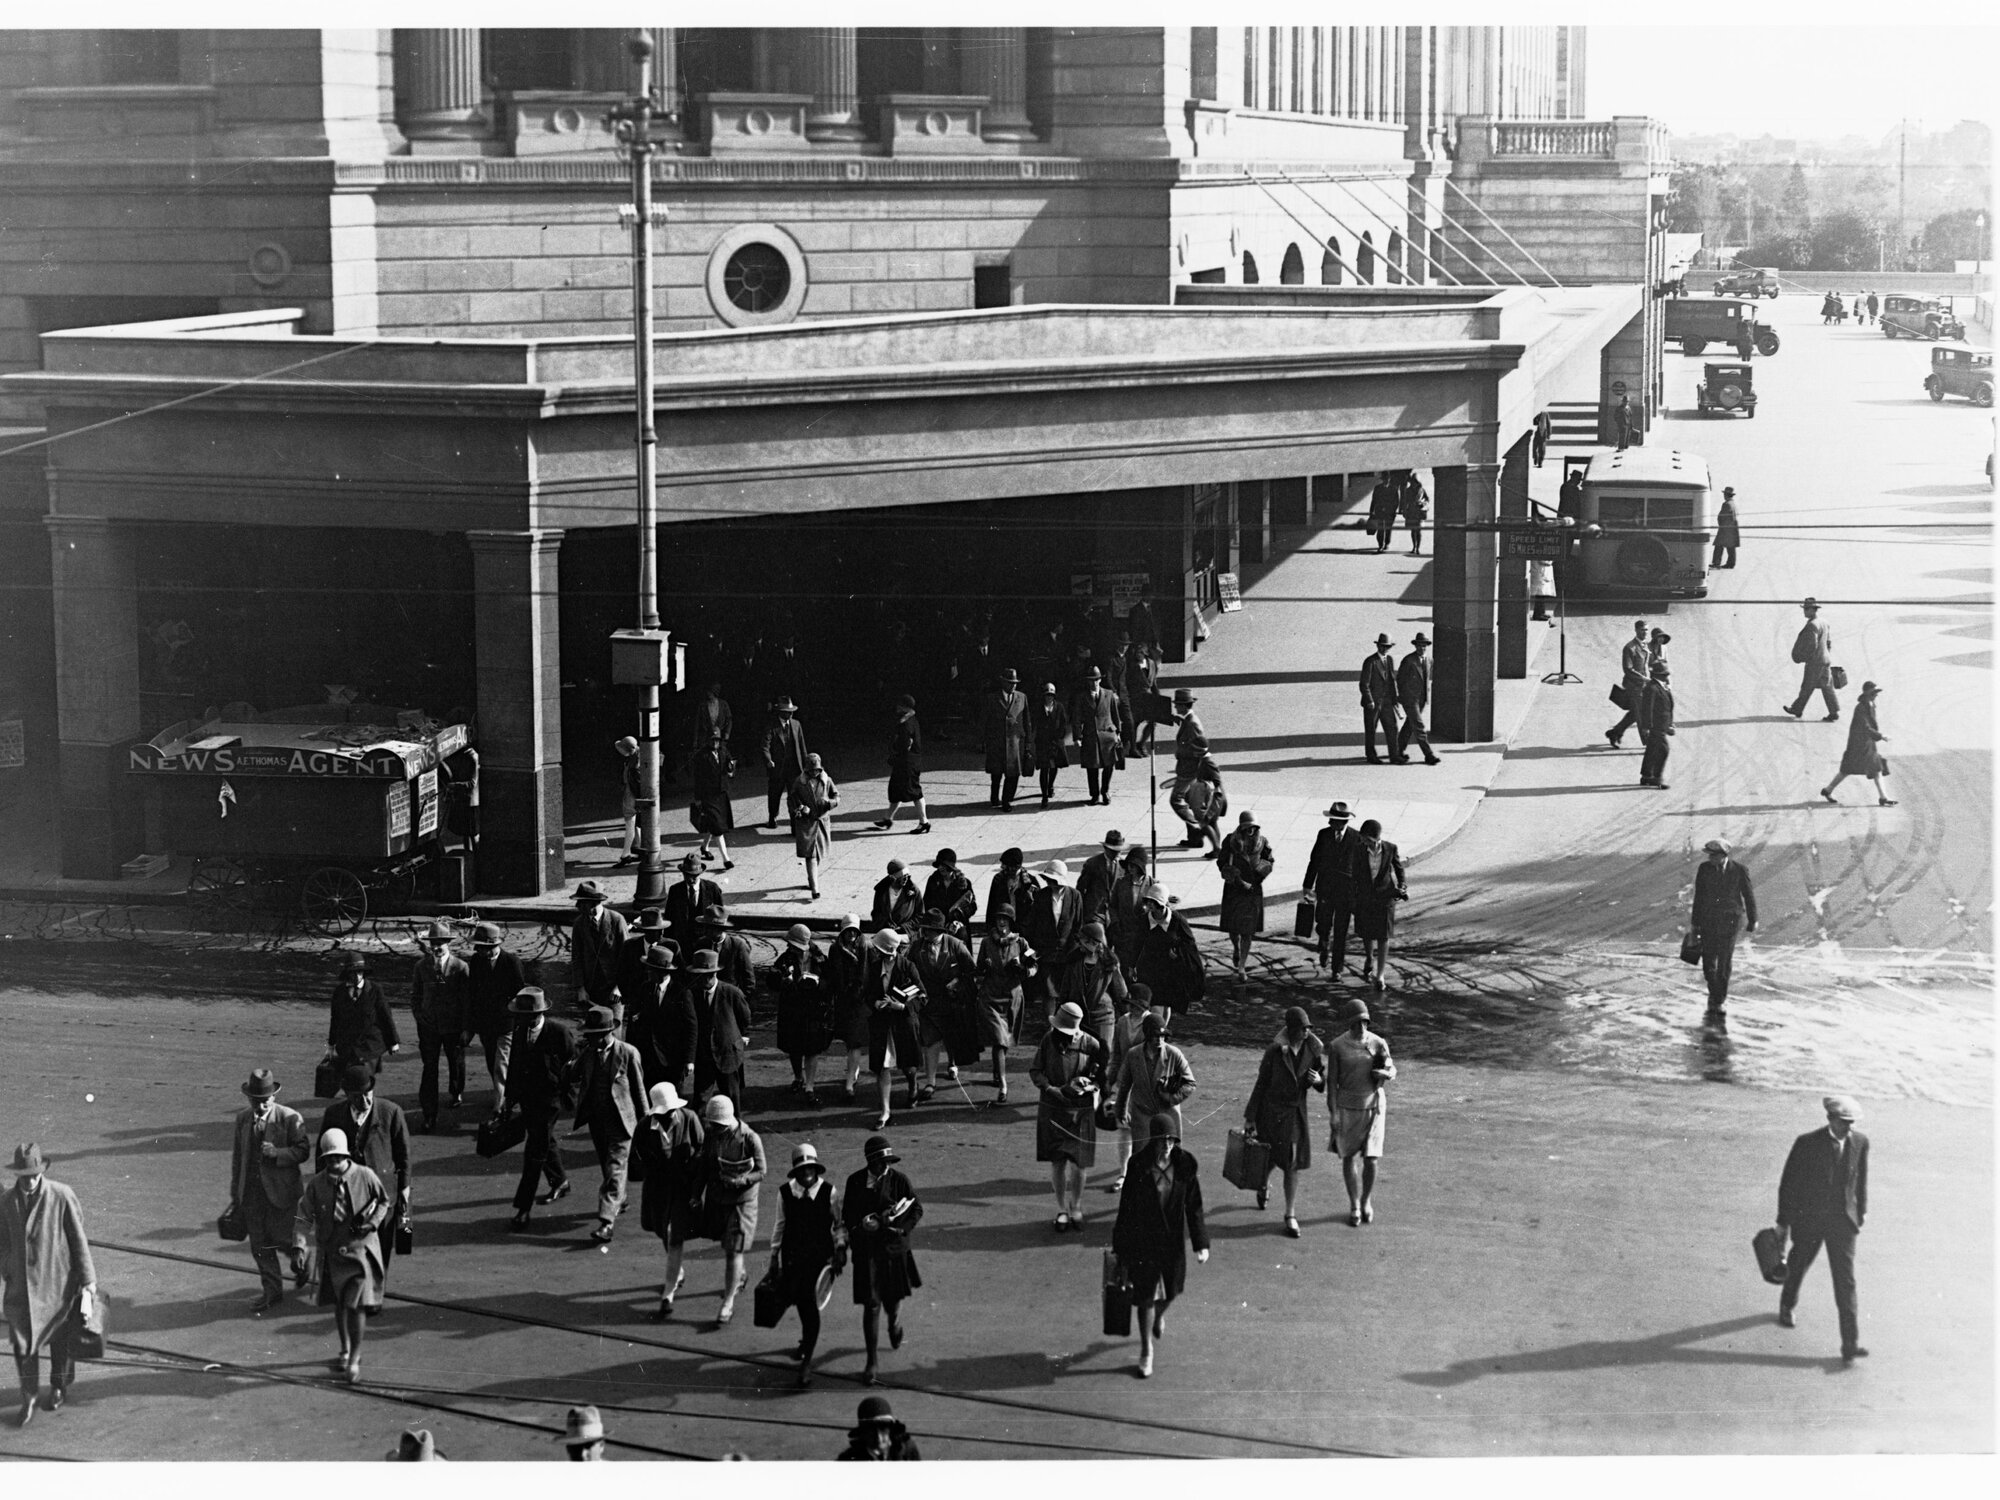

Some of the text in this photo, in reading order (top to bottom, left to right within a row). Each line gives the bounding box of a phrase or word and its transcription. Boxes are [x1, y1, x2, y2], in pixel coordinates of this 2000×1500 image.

[130, 749, 235, 772] NEWS
[287, 750, 396, 775] AGENT
[406, 743, 436, 781] NEWS
